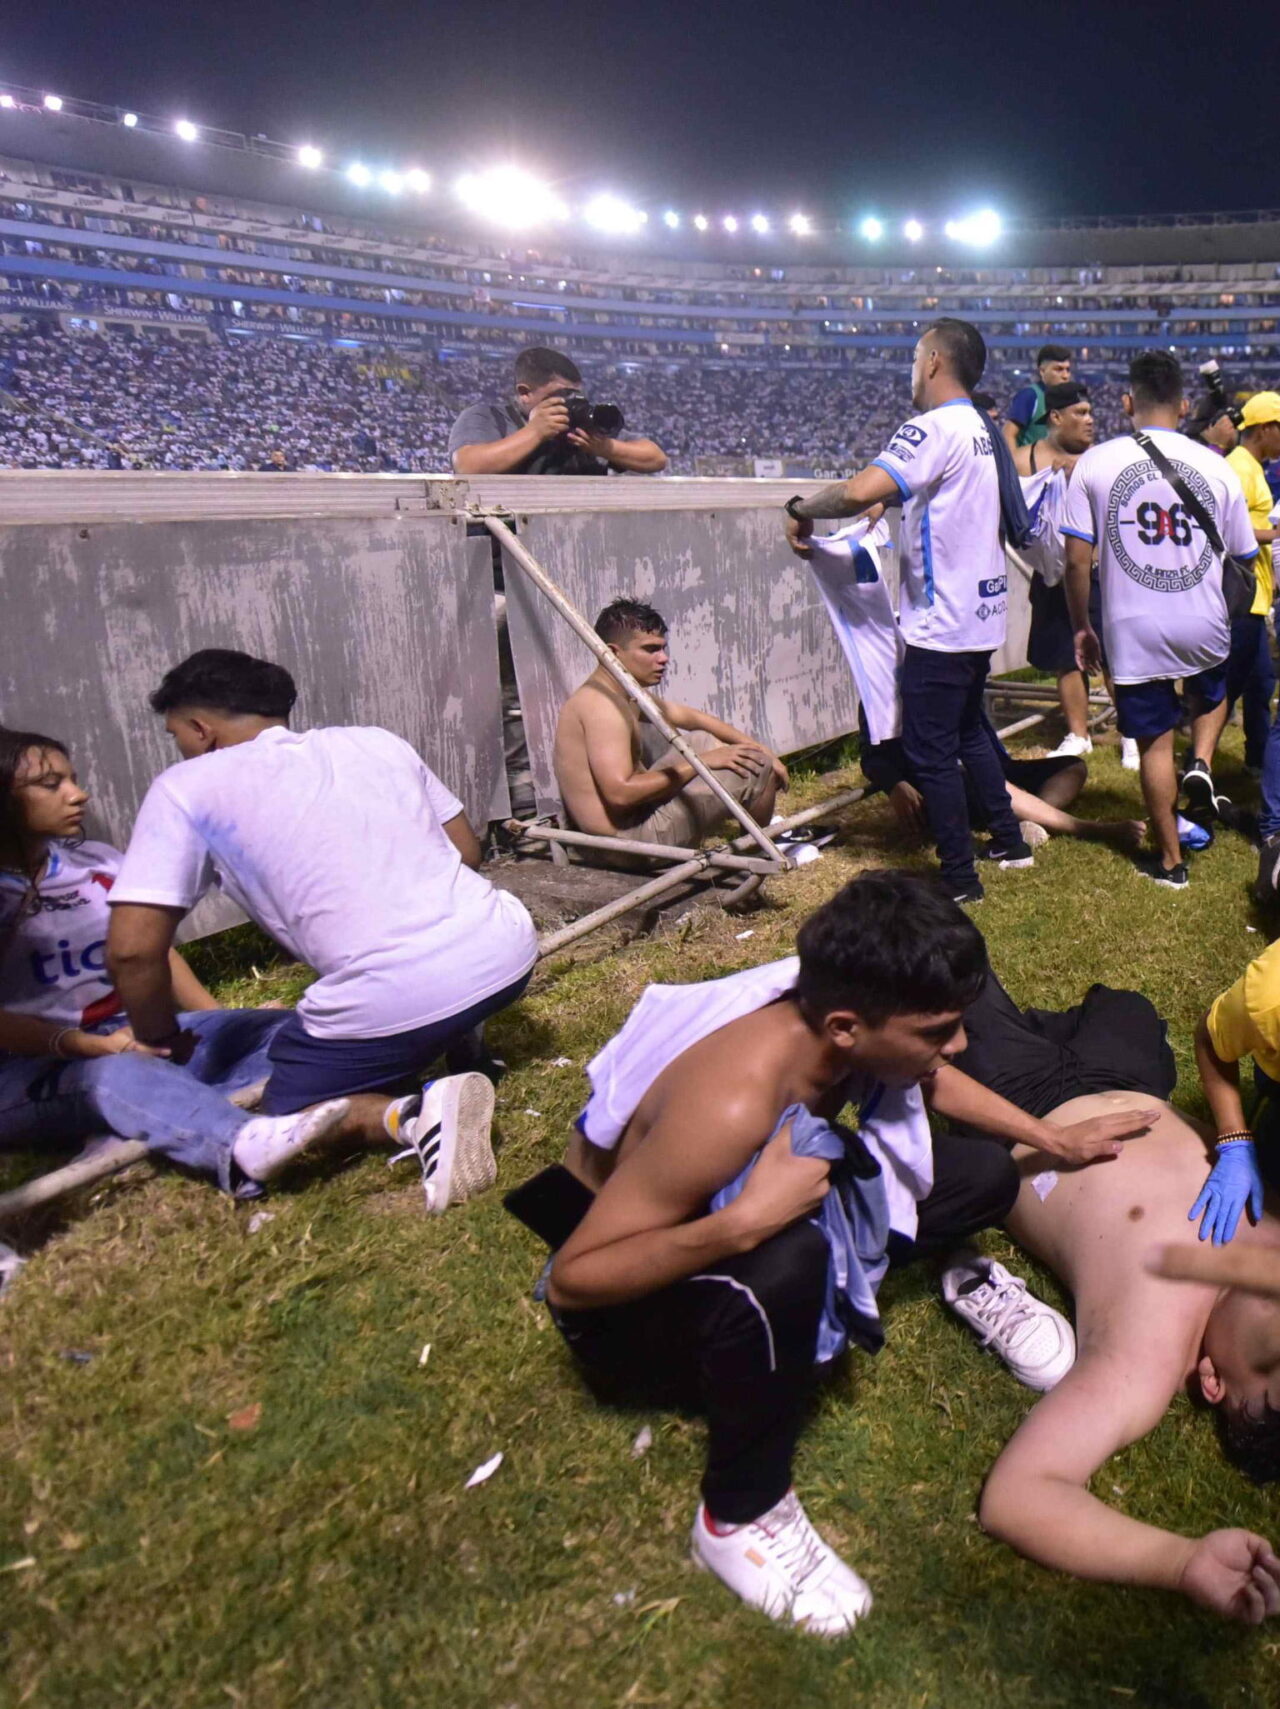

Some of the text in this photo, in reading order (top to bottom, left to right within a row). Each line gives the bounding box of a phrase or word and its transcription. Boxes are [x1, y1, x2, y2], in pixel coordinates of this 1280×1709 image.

[17, 296, 74, 311] WILLIAMS
[103, 304, 208, 324] SHERWIN WILLIAMS
[1120, 476, 1146, 508] SOMOS
[1144, 563, 1179, 579] ALIANZA
